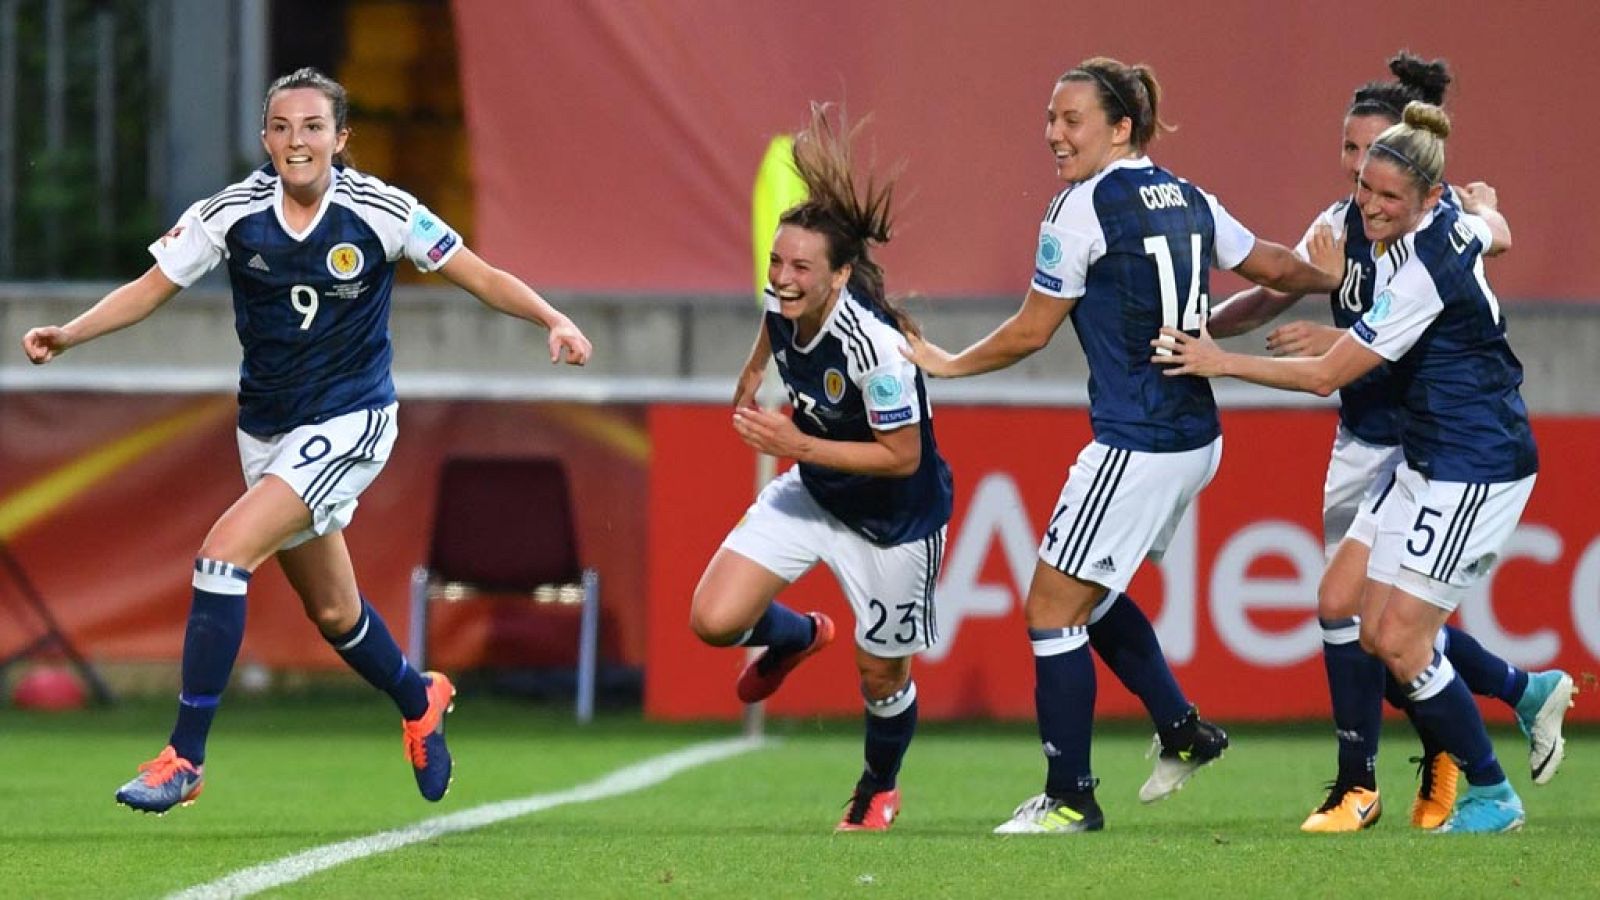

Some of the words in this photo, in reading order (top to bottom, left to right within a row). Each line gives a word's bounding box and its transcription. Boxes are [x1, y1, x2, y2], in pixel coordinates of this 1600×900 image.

[291, 285, 319, 330] 9
[1143, 234, 1208, 358] 14
[1339, 258, 1362, 312] 10
[294, 435, 331, 469] 9
[1405, 505, 1442, 557] 5
[865, 598, 918, 645] 23
